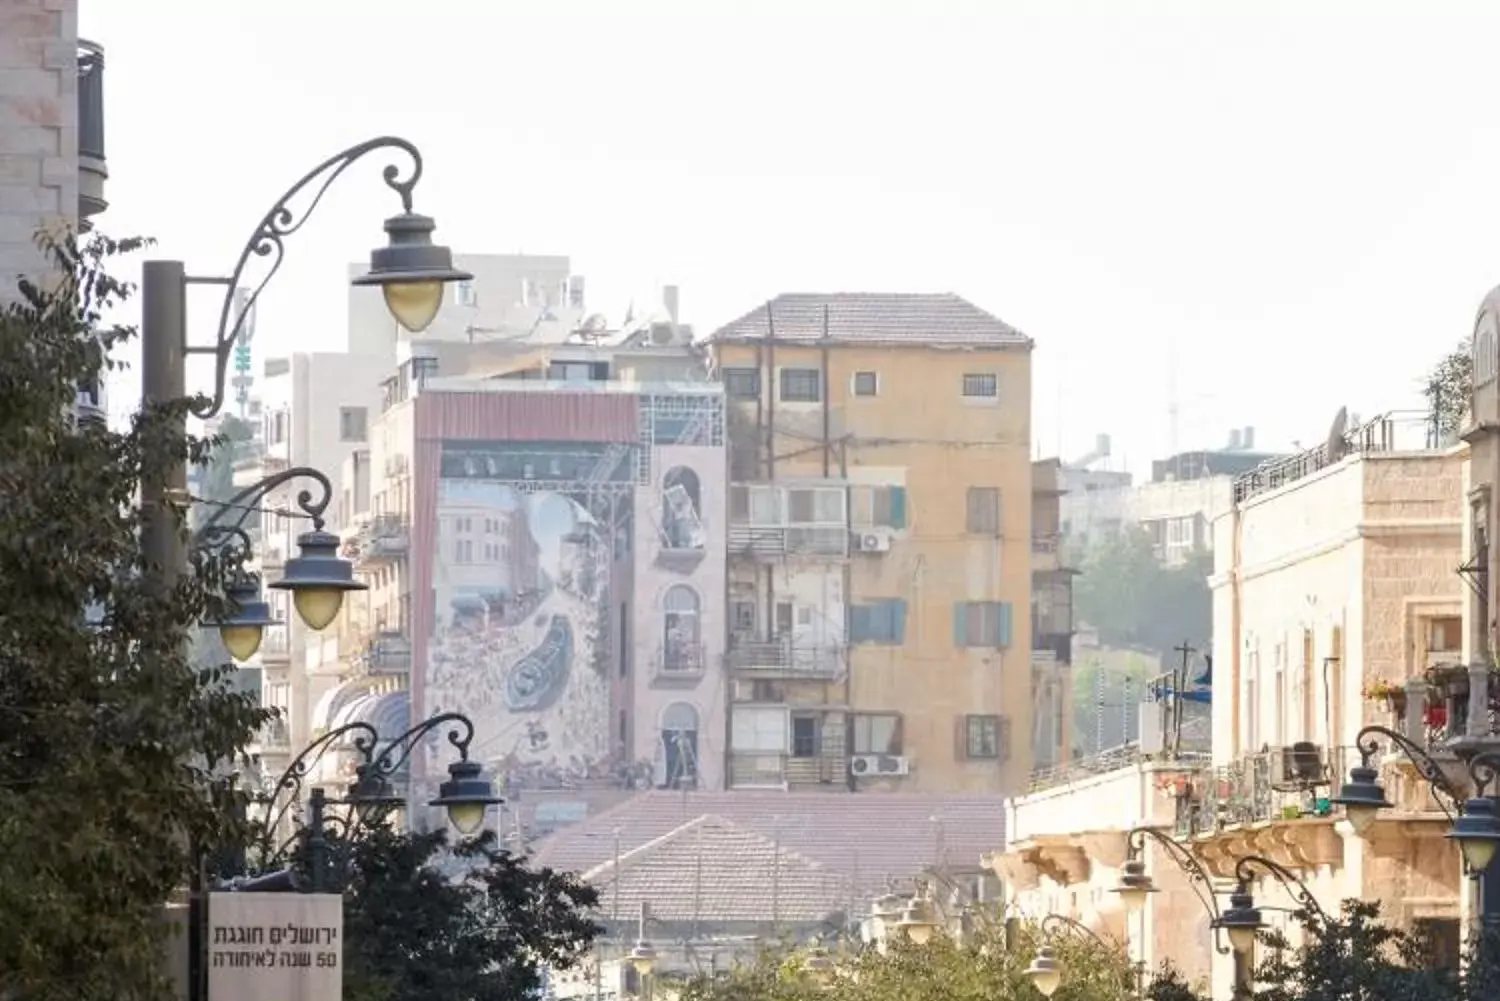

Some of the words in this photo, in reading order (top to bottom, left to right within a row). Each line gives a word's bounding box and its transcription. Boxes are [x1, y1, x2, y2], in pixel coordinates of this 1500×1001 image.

[214, 927, 264, 944] חוגגת
[270, 923, 337, 944] ירושלים
[213, 949, 275, 967] לאיחודה
[280, 952, 311, 967] שנה
[316, 952, 337, 967] 50
